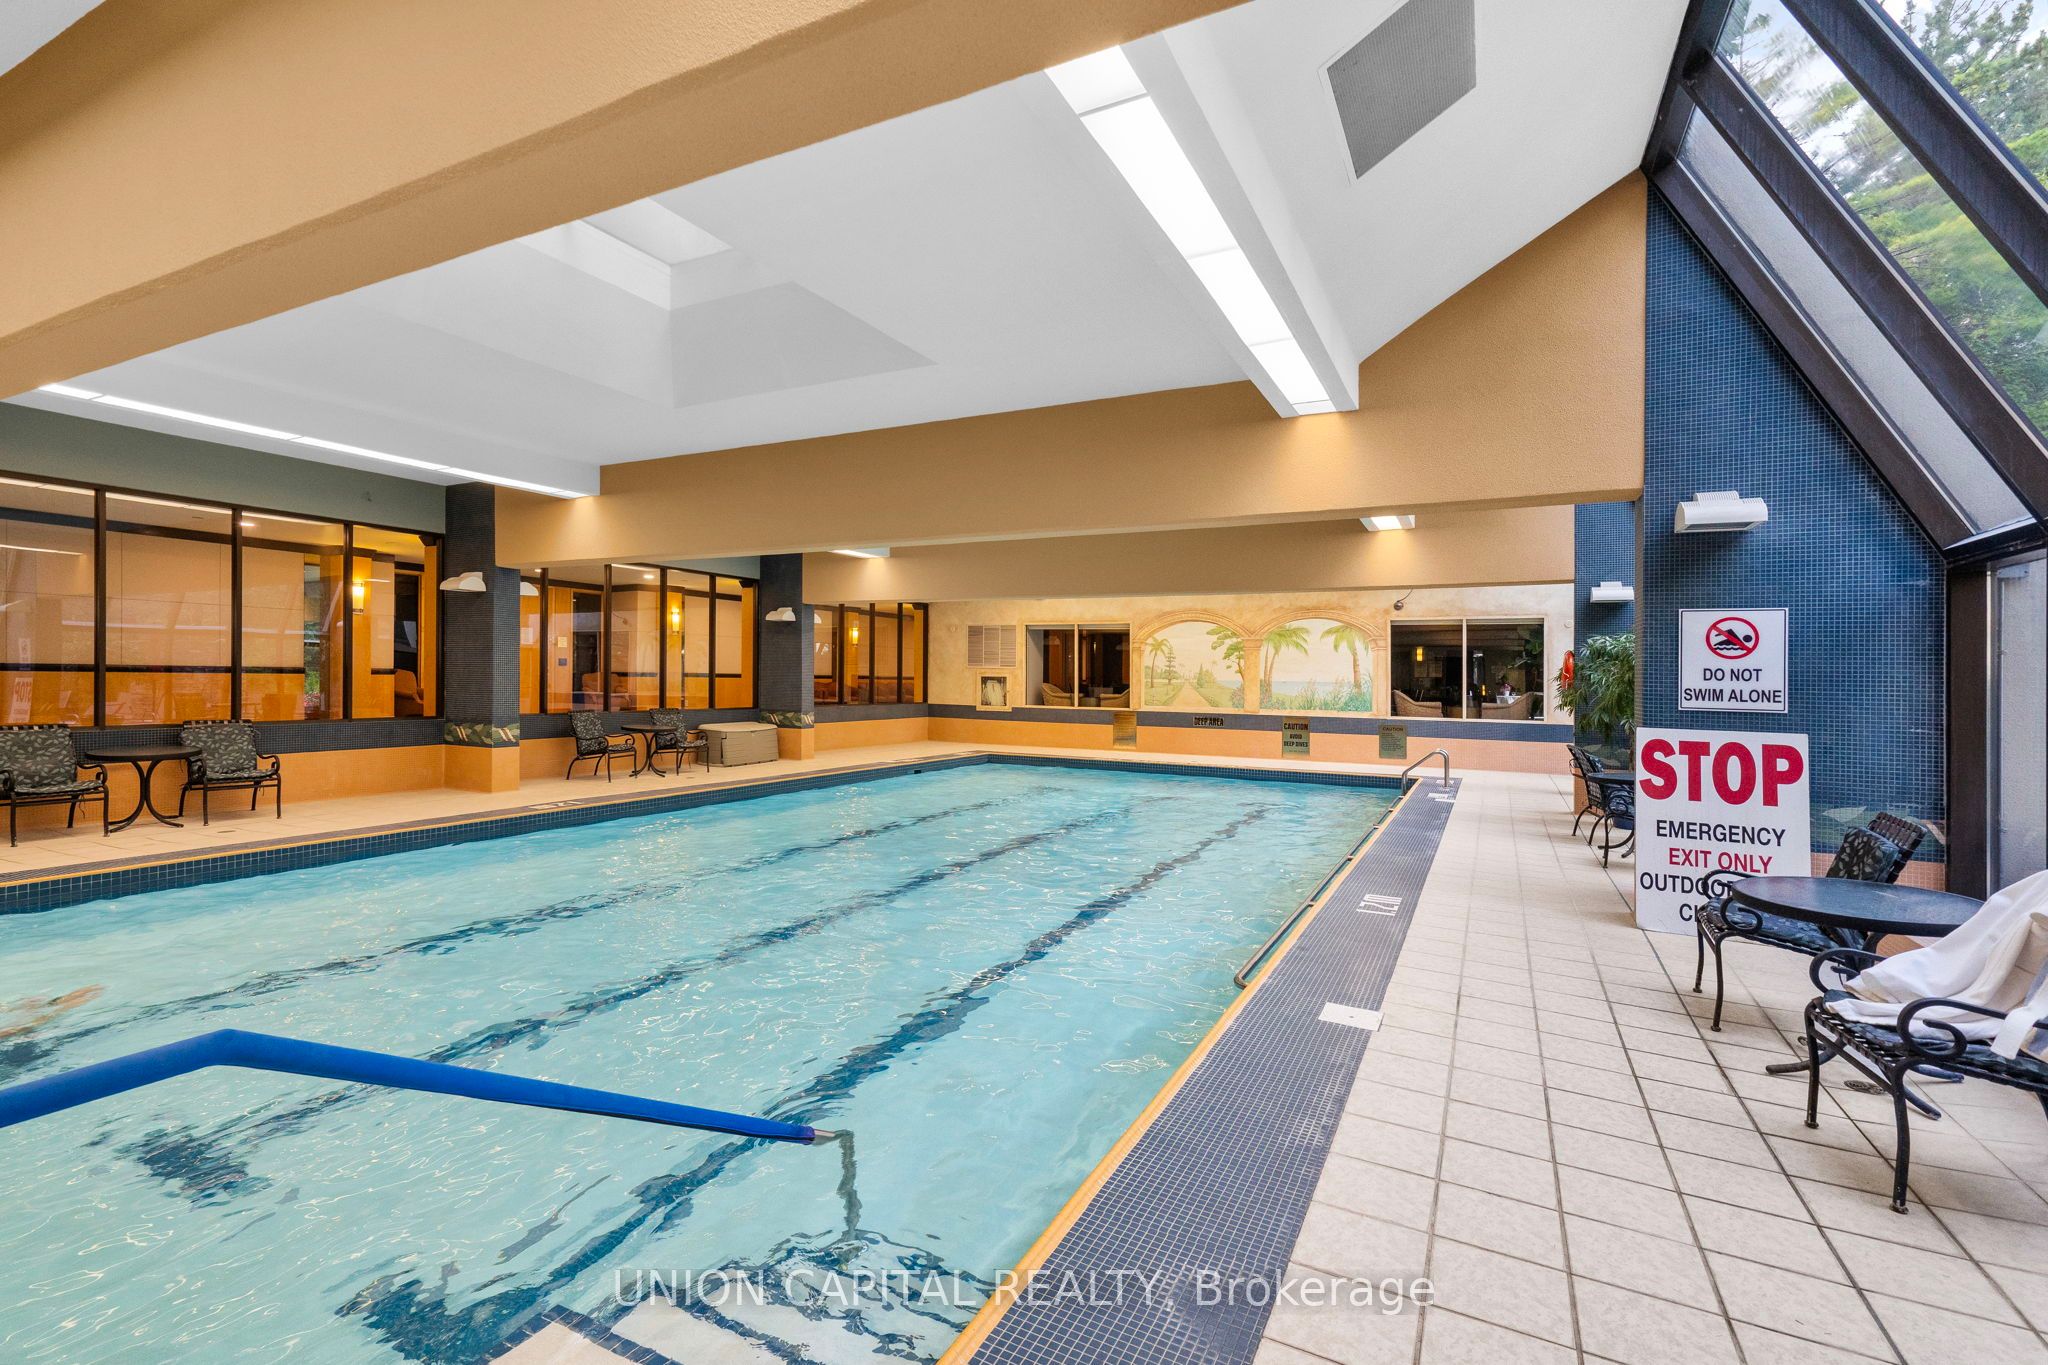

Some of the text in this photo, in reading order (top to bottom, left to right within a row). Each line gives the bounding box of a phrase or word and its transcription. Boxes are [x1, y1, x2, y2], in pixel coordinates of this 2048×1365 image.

[1703, 668, 1762, 682] DO NOT
[1683, 688, 1783, 704] SWIM ALONE
[1194, 717, 1224, 727] DEEP AREA
[1283, 722, 1309, 731] CAUTION
[1639, 738, 1804, 807] STOP
[1656, 819, 1786, 847] EMERGENCY
[1669, 847, 1773, 874] EXIT ONLY
